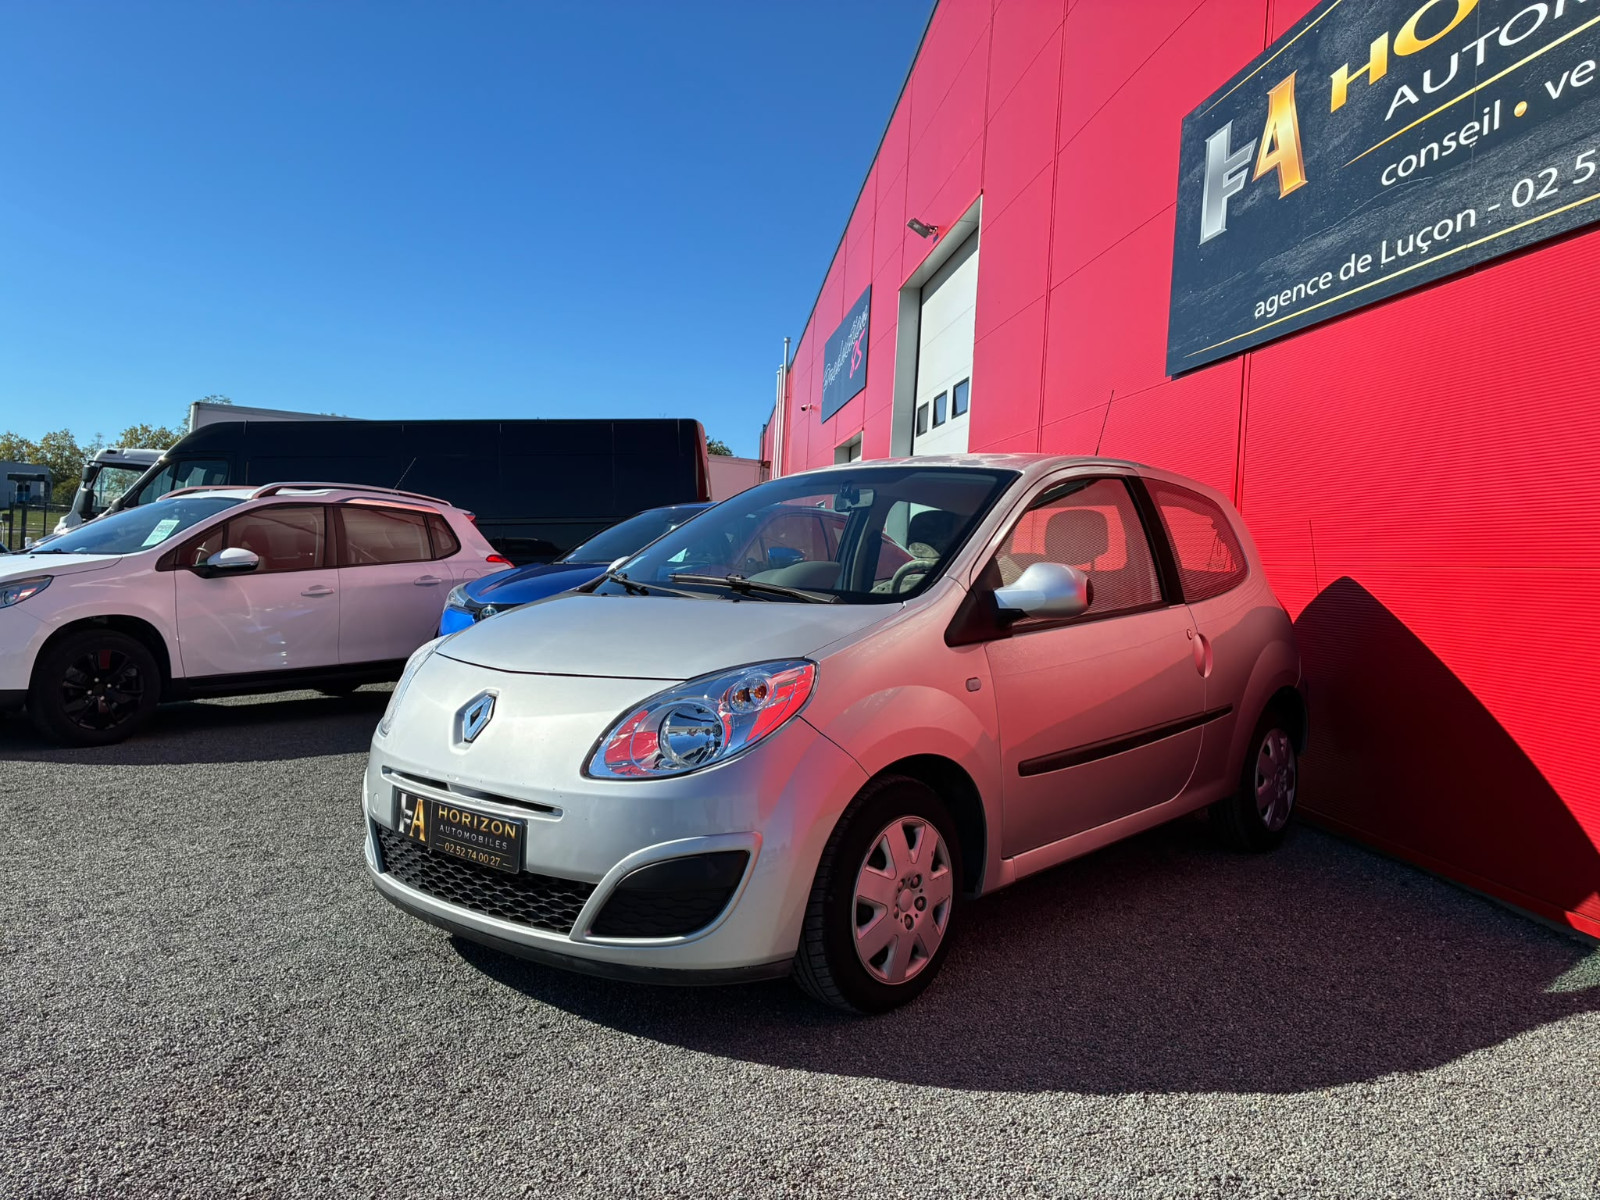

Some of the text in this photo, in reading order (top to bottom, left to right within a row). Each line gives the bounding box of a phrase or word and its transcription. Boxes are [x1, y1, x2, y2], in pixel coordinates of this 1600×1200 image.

[1381, 59, 1597, 187] conseil ve
[1254, 271, 1332, 320] agence
[1339, 253, 1372, 282] de
[1380, 207, 1476, 265] Luçon
[1511, 167, 1559, 208] 02
[1572, 148, 1596, 185] 5
[438, 804, 517, 839] HORIZON
[439, 824, 508, 850] AUTOMOBILES
[444, 842, 500, 867] 02 52 74 00 27
